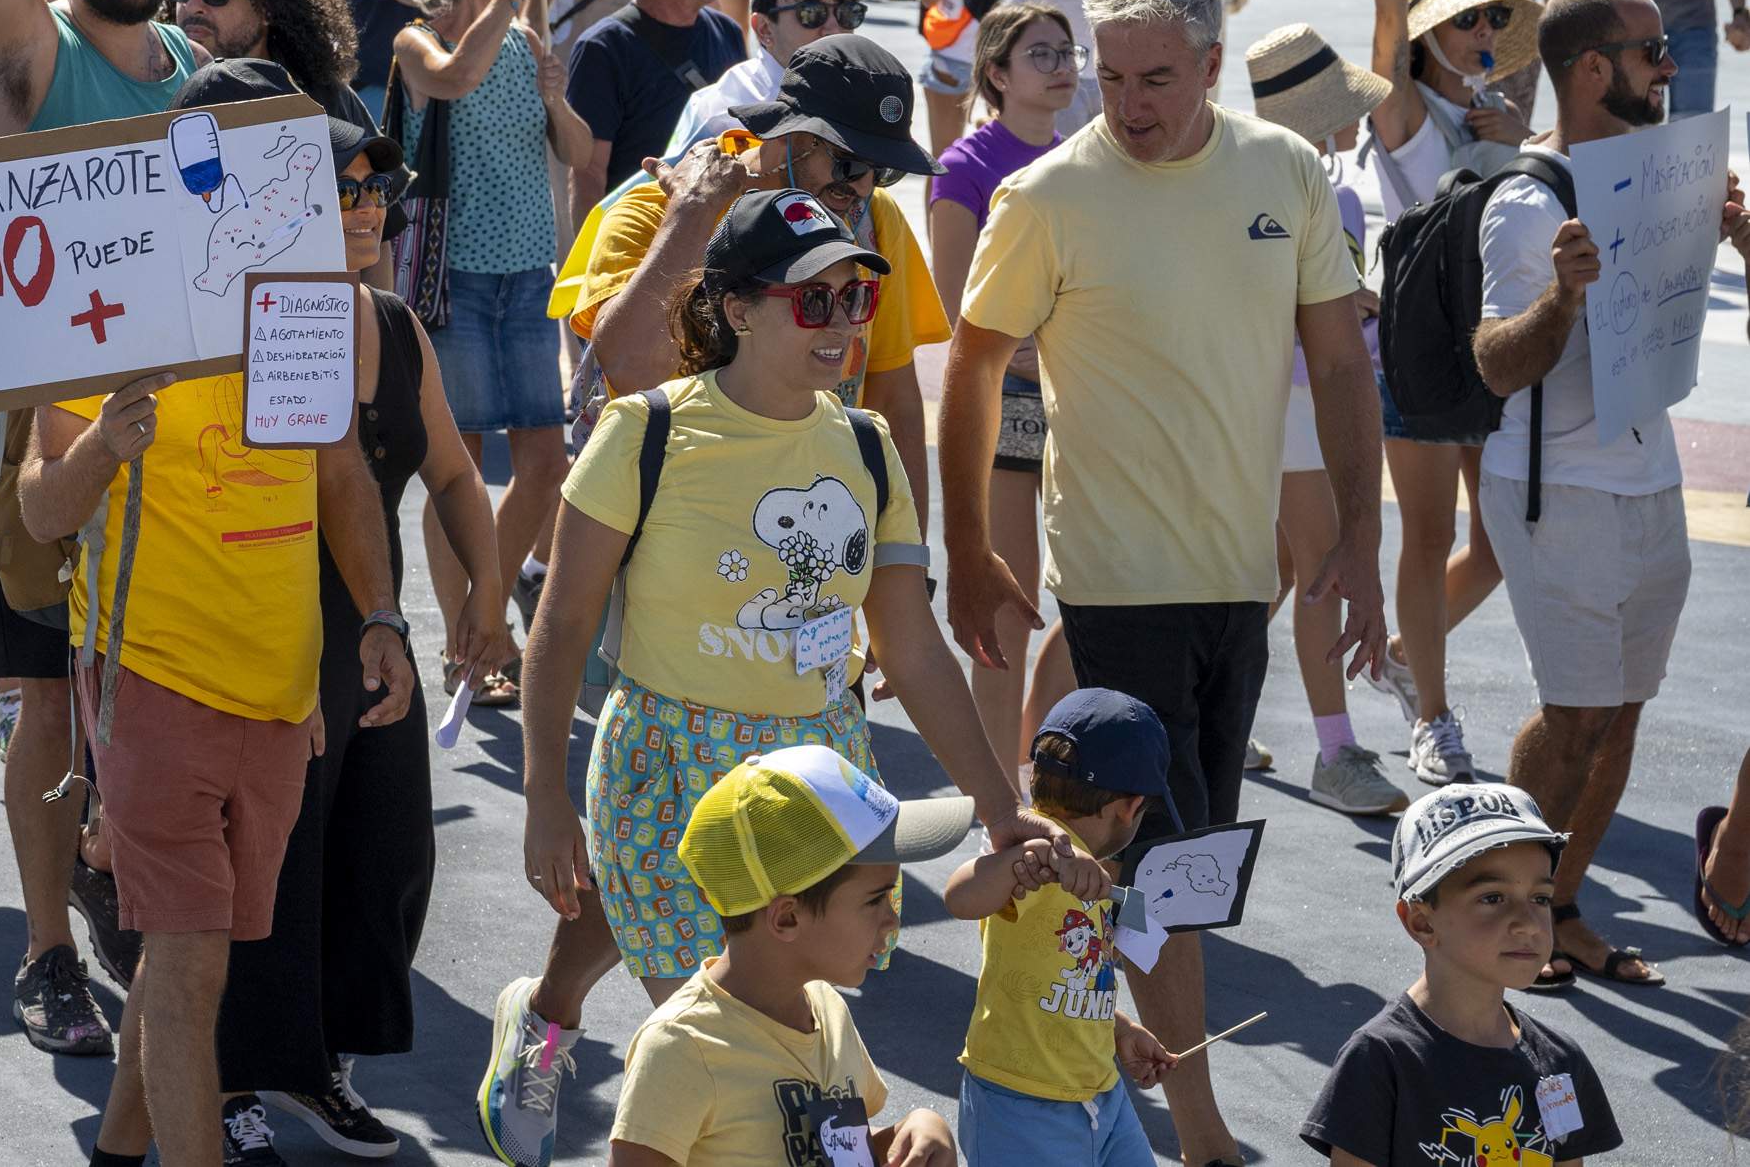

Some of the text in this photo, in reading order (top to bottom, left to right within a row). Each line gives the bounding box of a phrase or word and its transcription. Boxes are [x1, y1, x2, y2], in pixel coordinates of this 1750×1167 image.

[64, 230, 155, 275] PUEDE
[255, 412, 329, 429] MUY GRAVE
